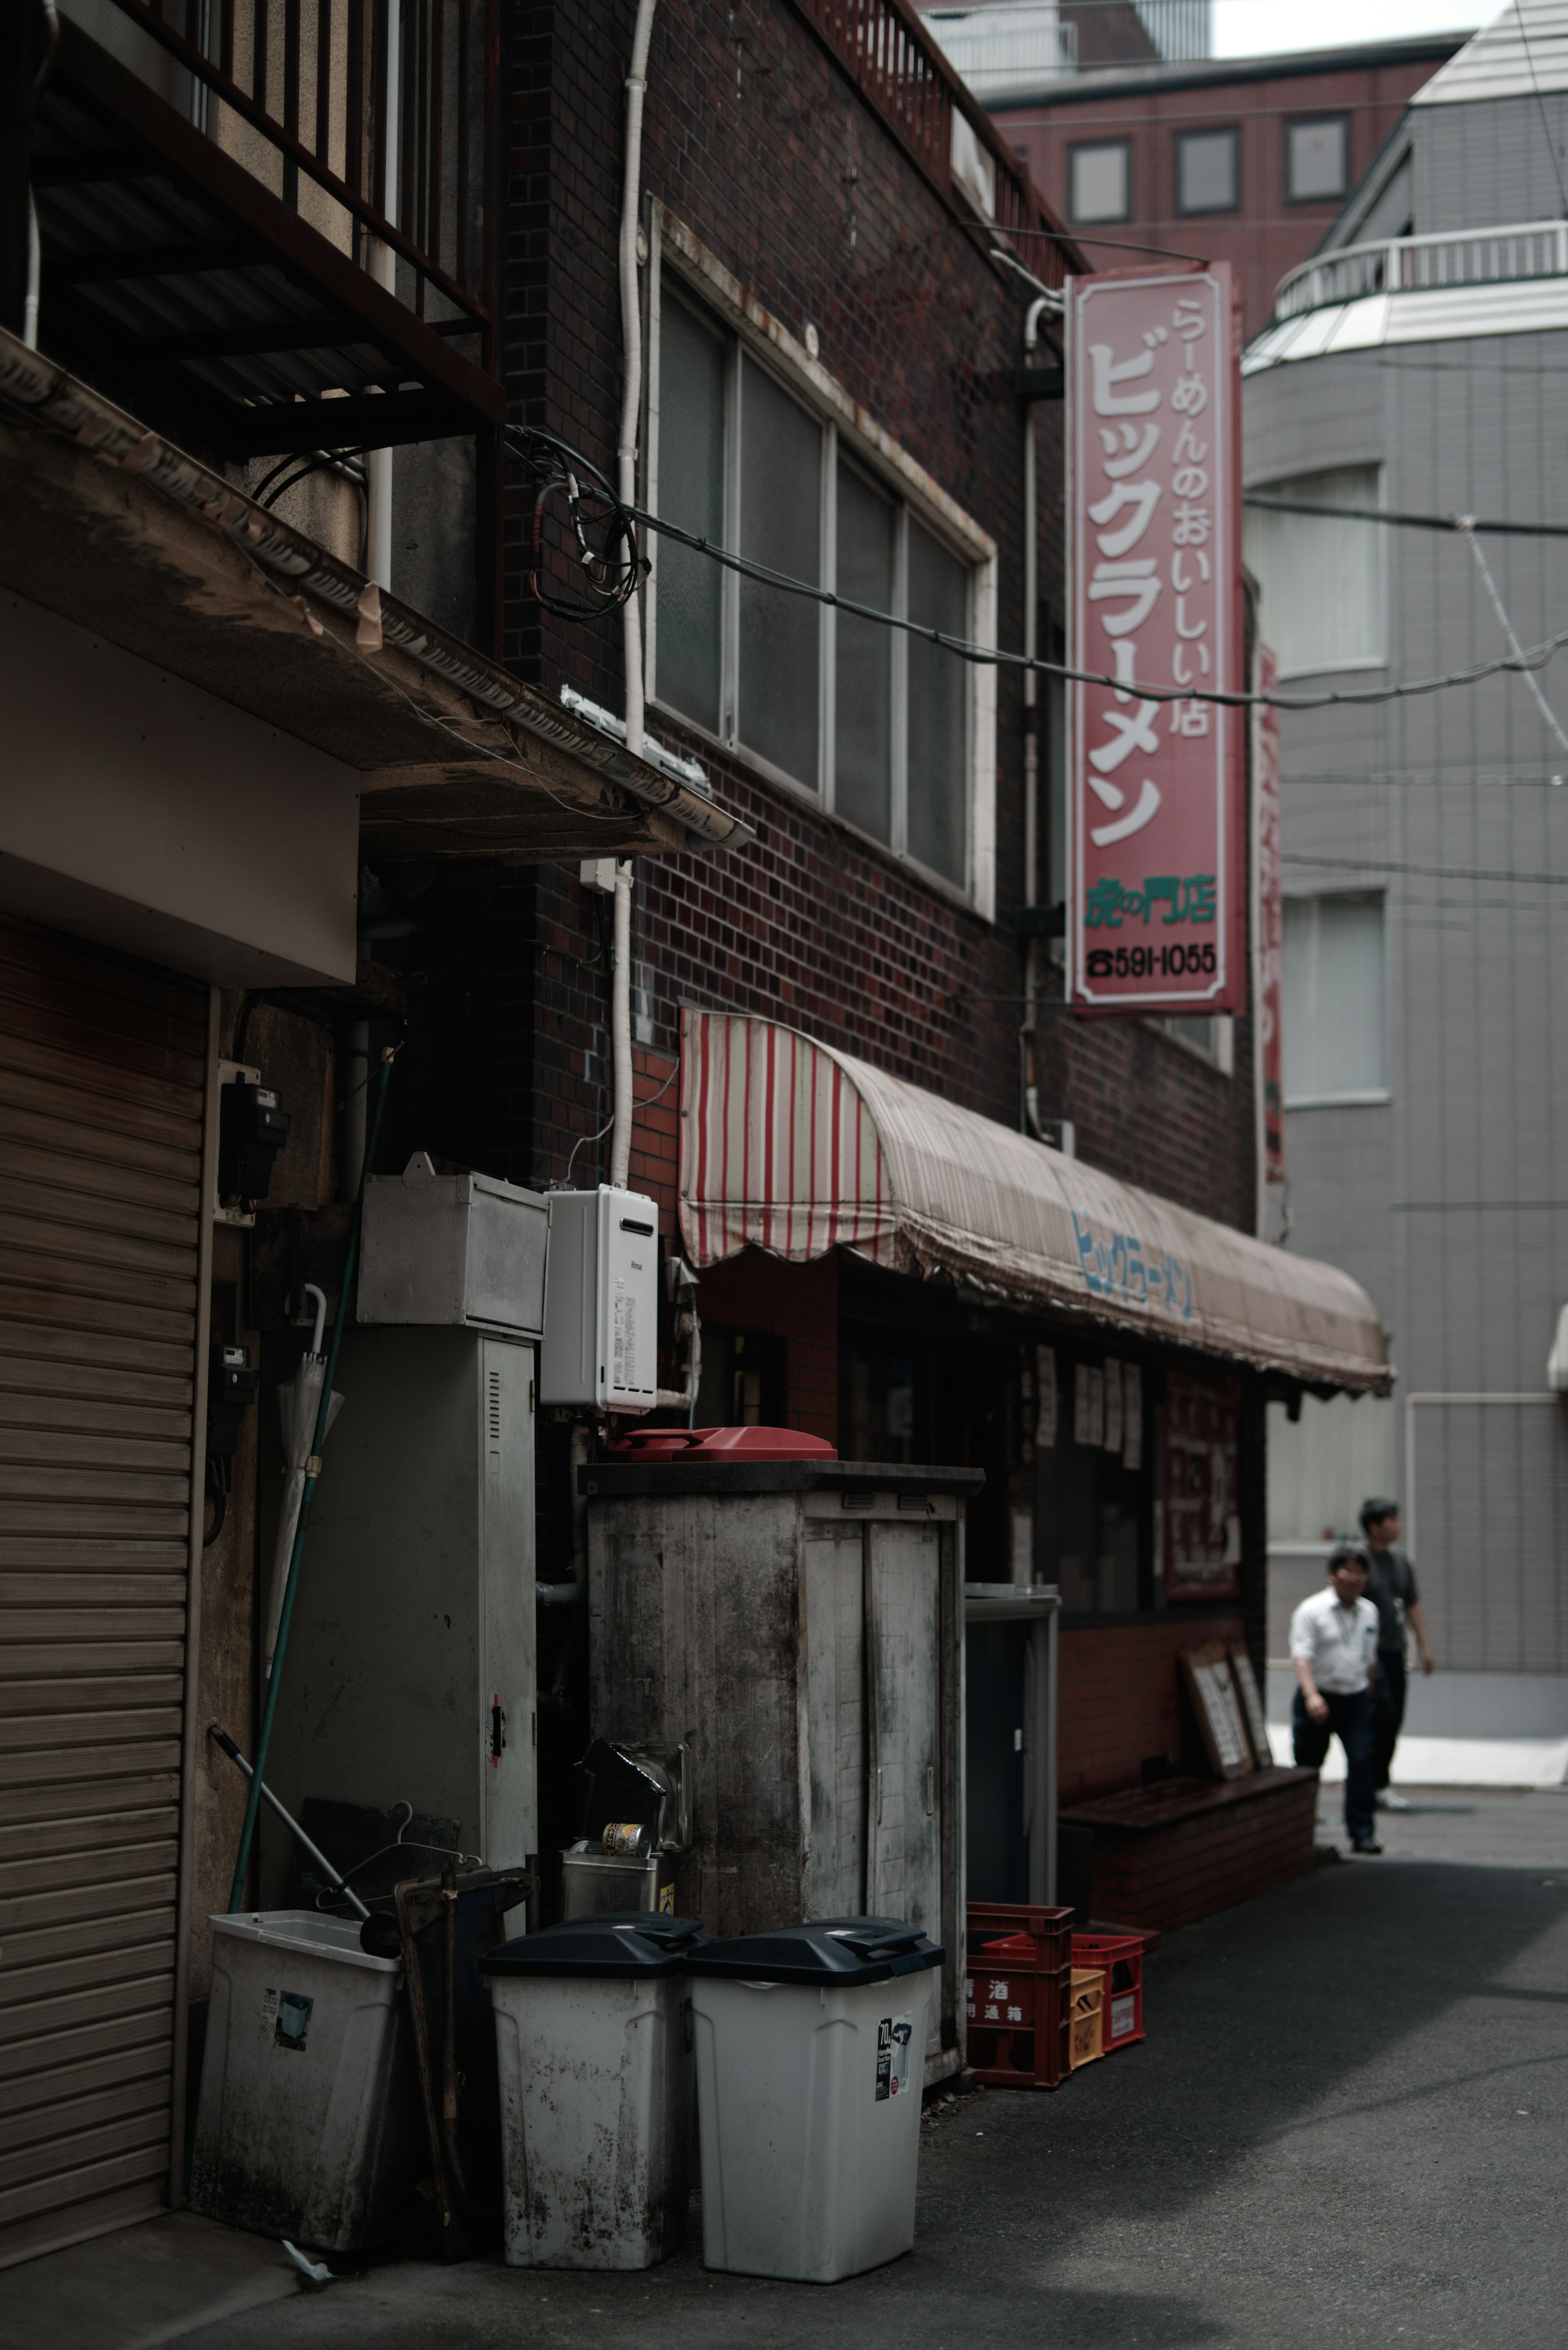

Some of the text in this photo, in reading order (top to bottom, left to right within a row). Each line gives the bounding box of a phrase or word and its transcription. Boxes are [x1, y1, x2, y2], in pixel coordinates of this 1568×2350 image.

[1170, 299, 1212, 736] らーめんのおいしい店
[1087, 327, 1169, 847] ビックラーメン
[1085, 874, 1216, 928] 虎の門店
[1115, 943, 1216, 977] 591-1055
[631, 1261, 642, 1270] Rinnai
